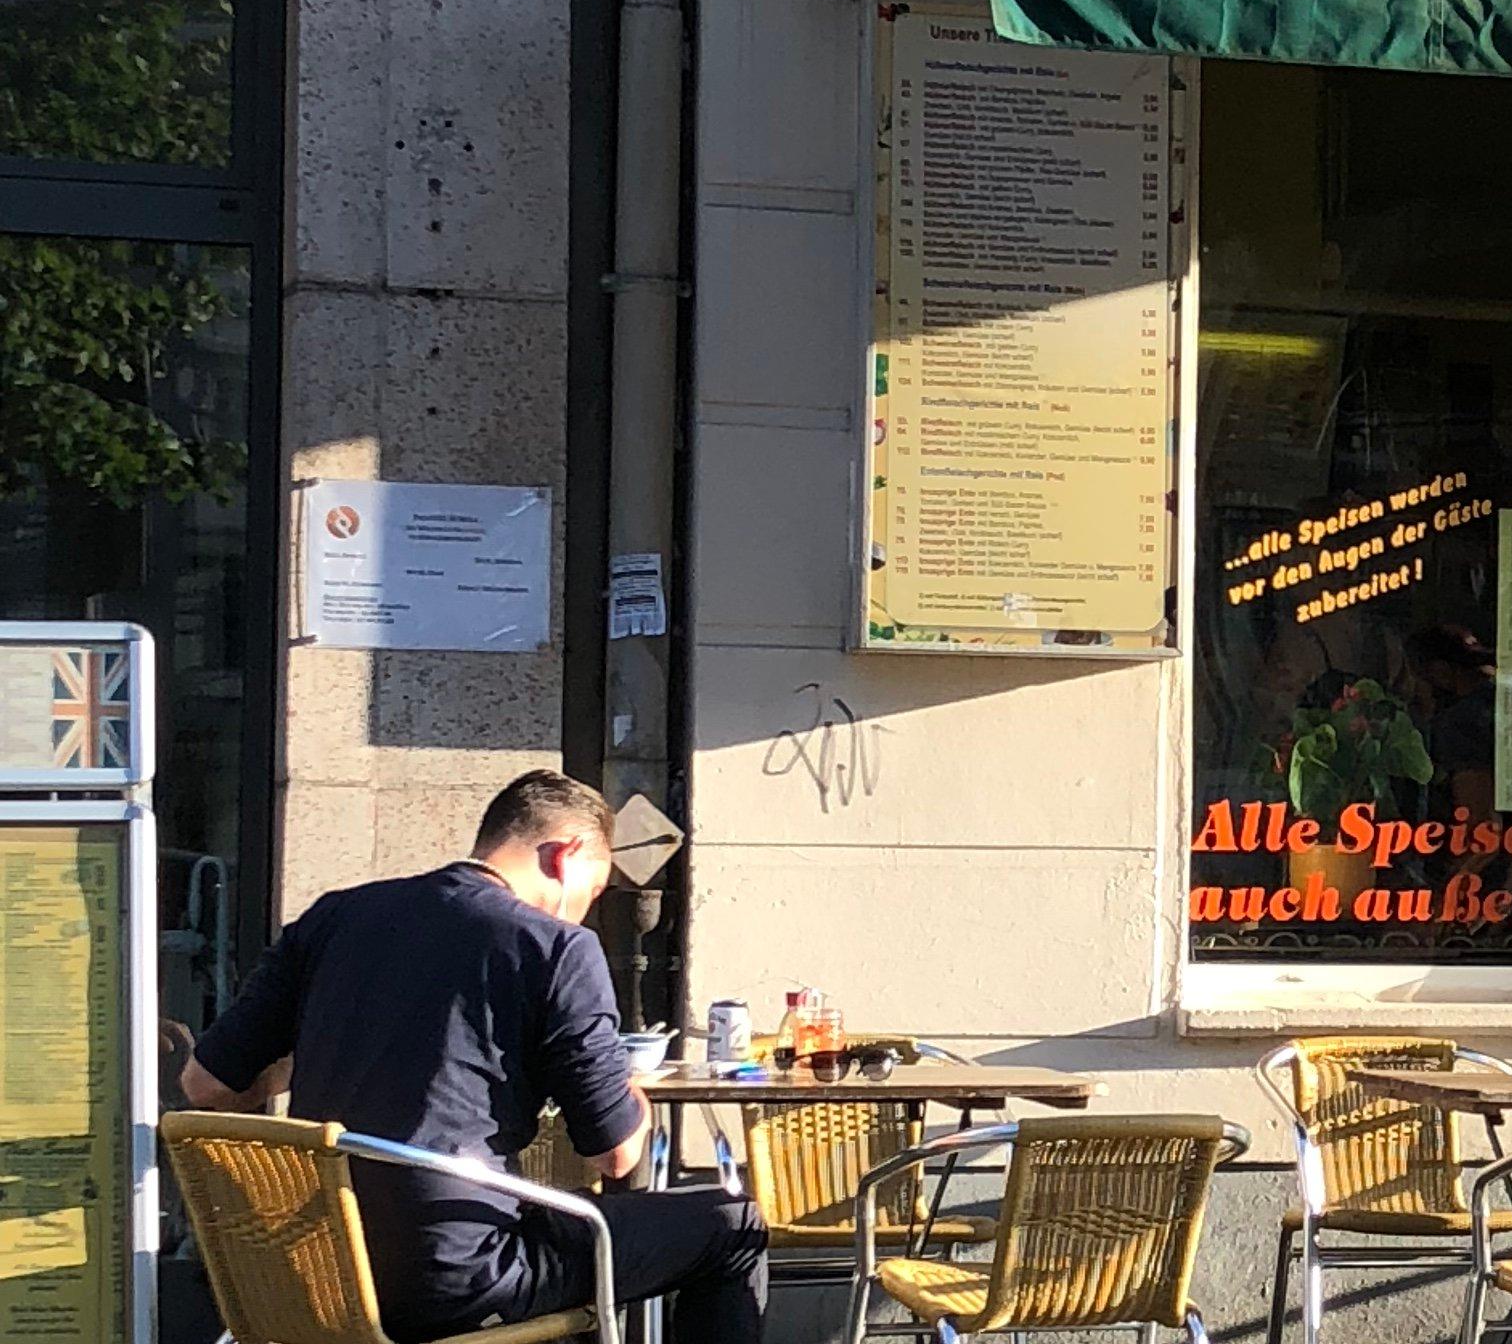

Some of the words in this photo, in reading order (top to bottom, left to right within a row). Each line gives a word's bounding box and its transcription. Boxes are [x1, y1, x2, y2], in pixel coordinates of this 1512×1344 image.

[1297, 500, 1385, 545] Speisen
[1389, 471, 1467, 511] werden
[1227, 578, 1266, 606] vor
[1271, 562, 1313, 590] den
[1318, 536, 1385, 574] Augen
[1390, 521, 1427, 548] der
[1432, 498, 1493, 532] Gäste
[1296, 564, 1410, 623] zubereitet
[1191, 798, 1321, 853] Alle
[1188, 870, 1342, 922] auch
